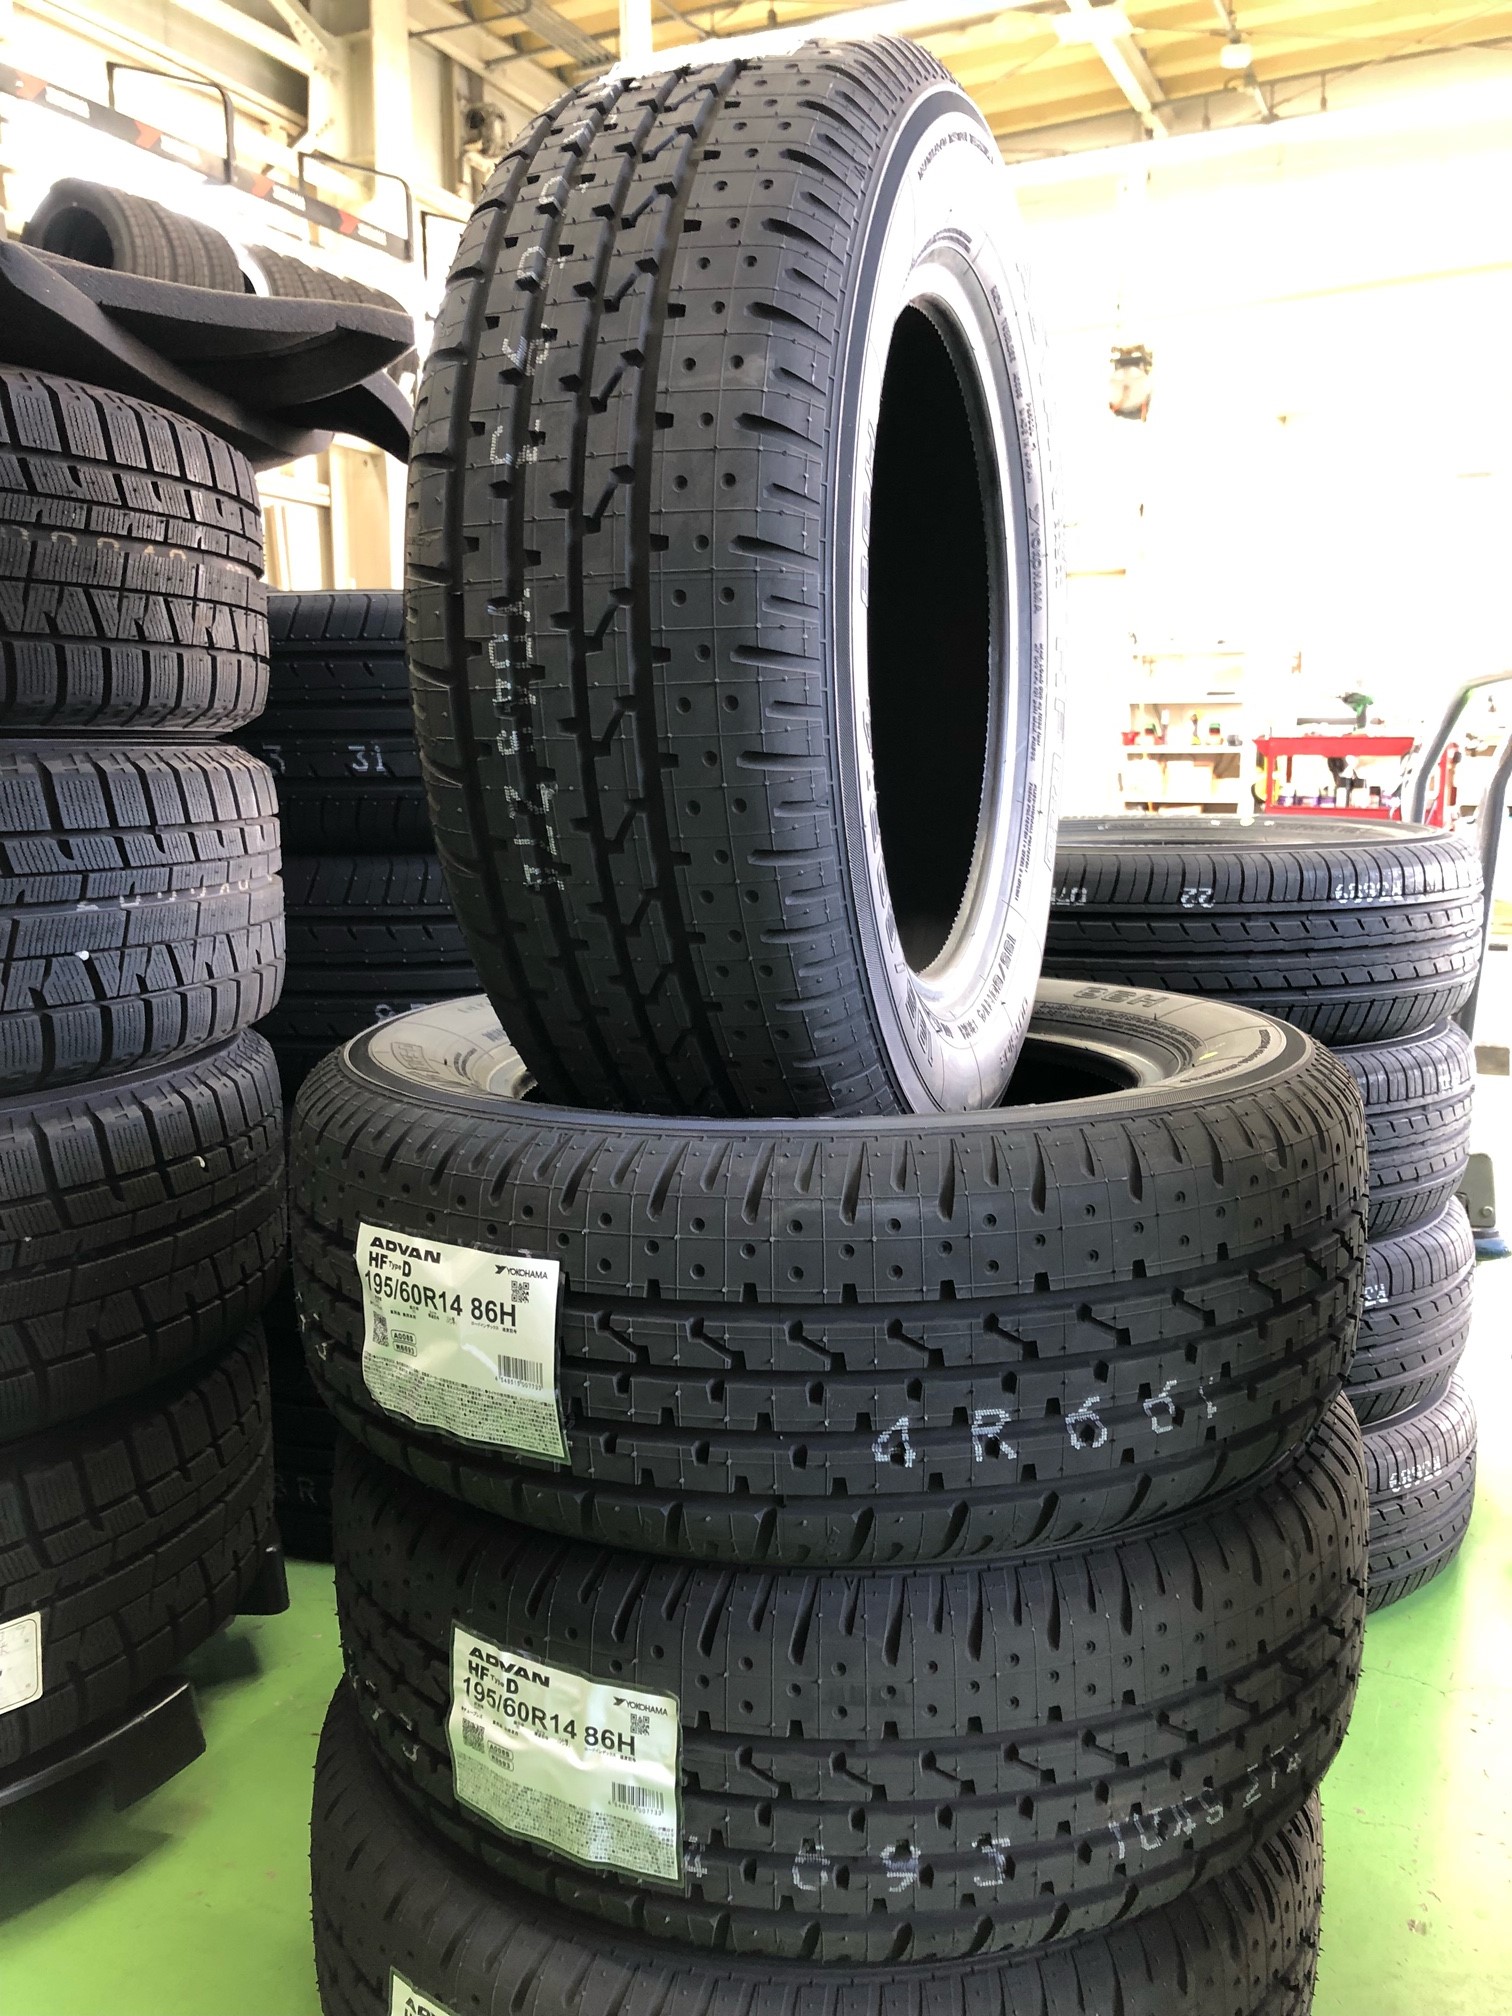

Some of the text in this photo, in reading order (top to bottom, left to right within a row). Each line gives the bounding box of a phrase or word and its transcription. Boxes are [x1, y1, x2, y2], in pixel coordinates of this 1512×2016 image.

[369, 1250, 412, 1278] HF Type D
[370, 1236, 441, 1264] ADVAN
[506, 1266, 548, 1279] YOKOHAMA
[365, 1269, 516, 1327] 195/60R14 86H
[468, 1660, 489, 1681] HF
[506, 1677, 519, 1694] D
[469, 1646, 550, 1688] ADVAN
[463, 1676, 577, 1740] 195/60R14
[584, 1725, 635, 1757] 86H
[626, 1700, 668, 1716] YOKOHAMA
